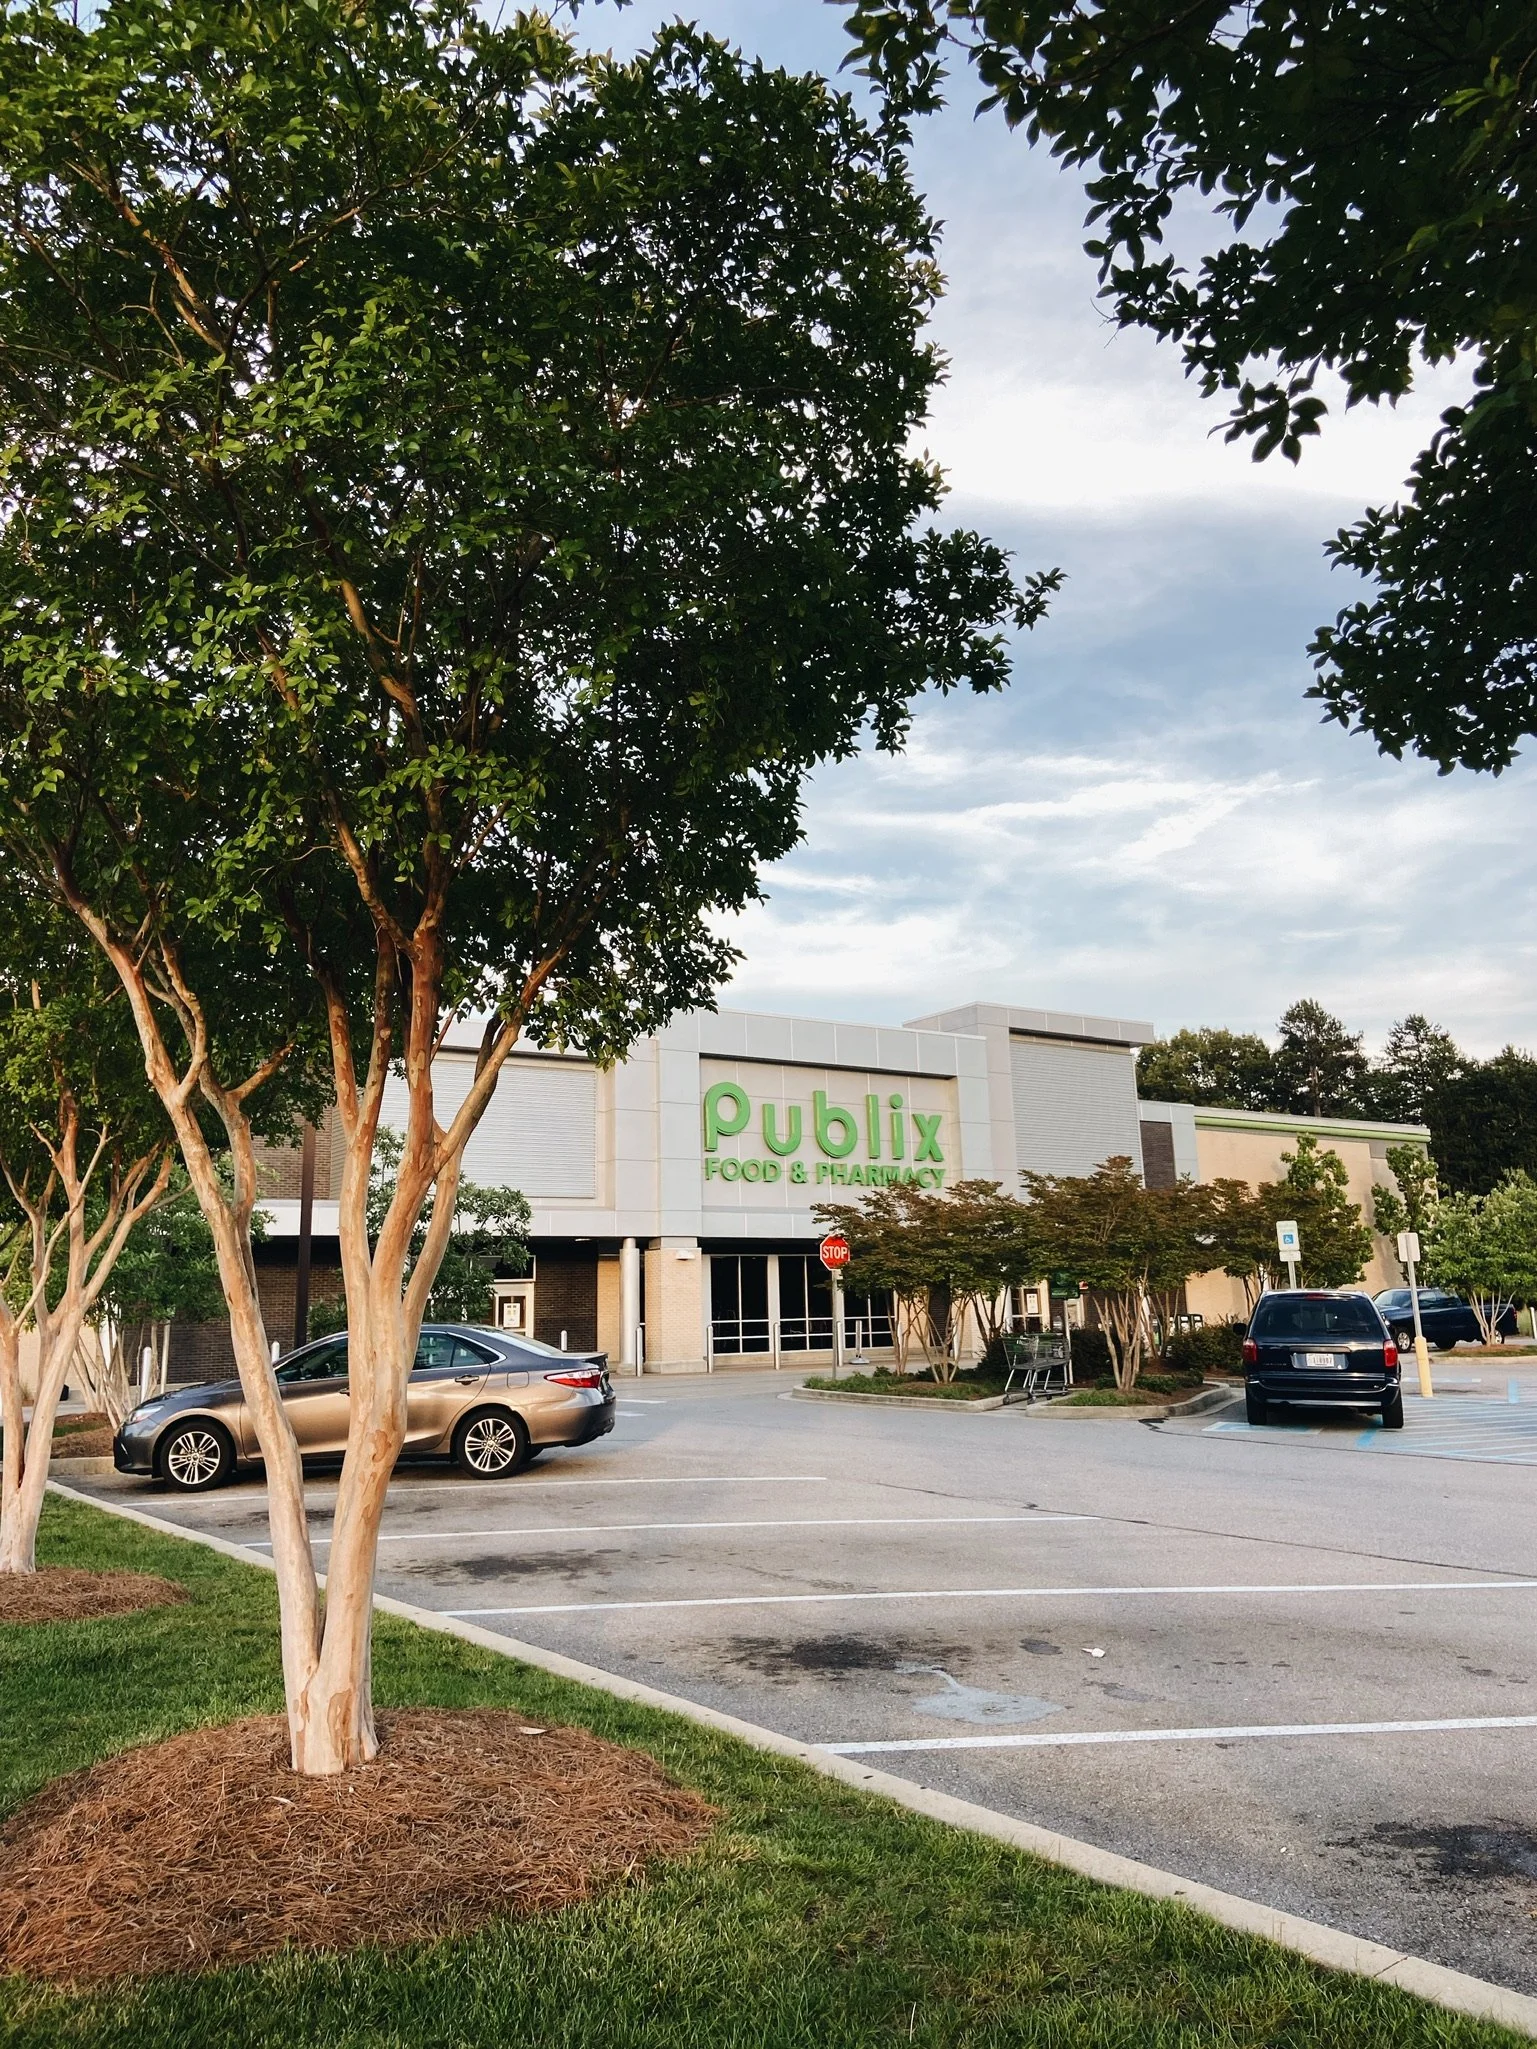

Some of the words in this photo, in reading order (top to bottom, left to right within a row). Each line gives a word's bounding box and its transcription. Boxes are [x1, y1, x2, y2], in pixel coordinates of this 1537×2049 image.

[705, 1082, 943, 1161] Publix
[705, 1158, 781, 1182] FOOD
[791, 1161, 808, 1183] &
[816, 1162, 946, 1188] PHARMACY
[822, 1245, 848, 1259] STOP
